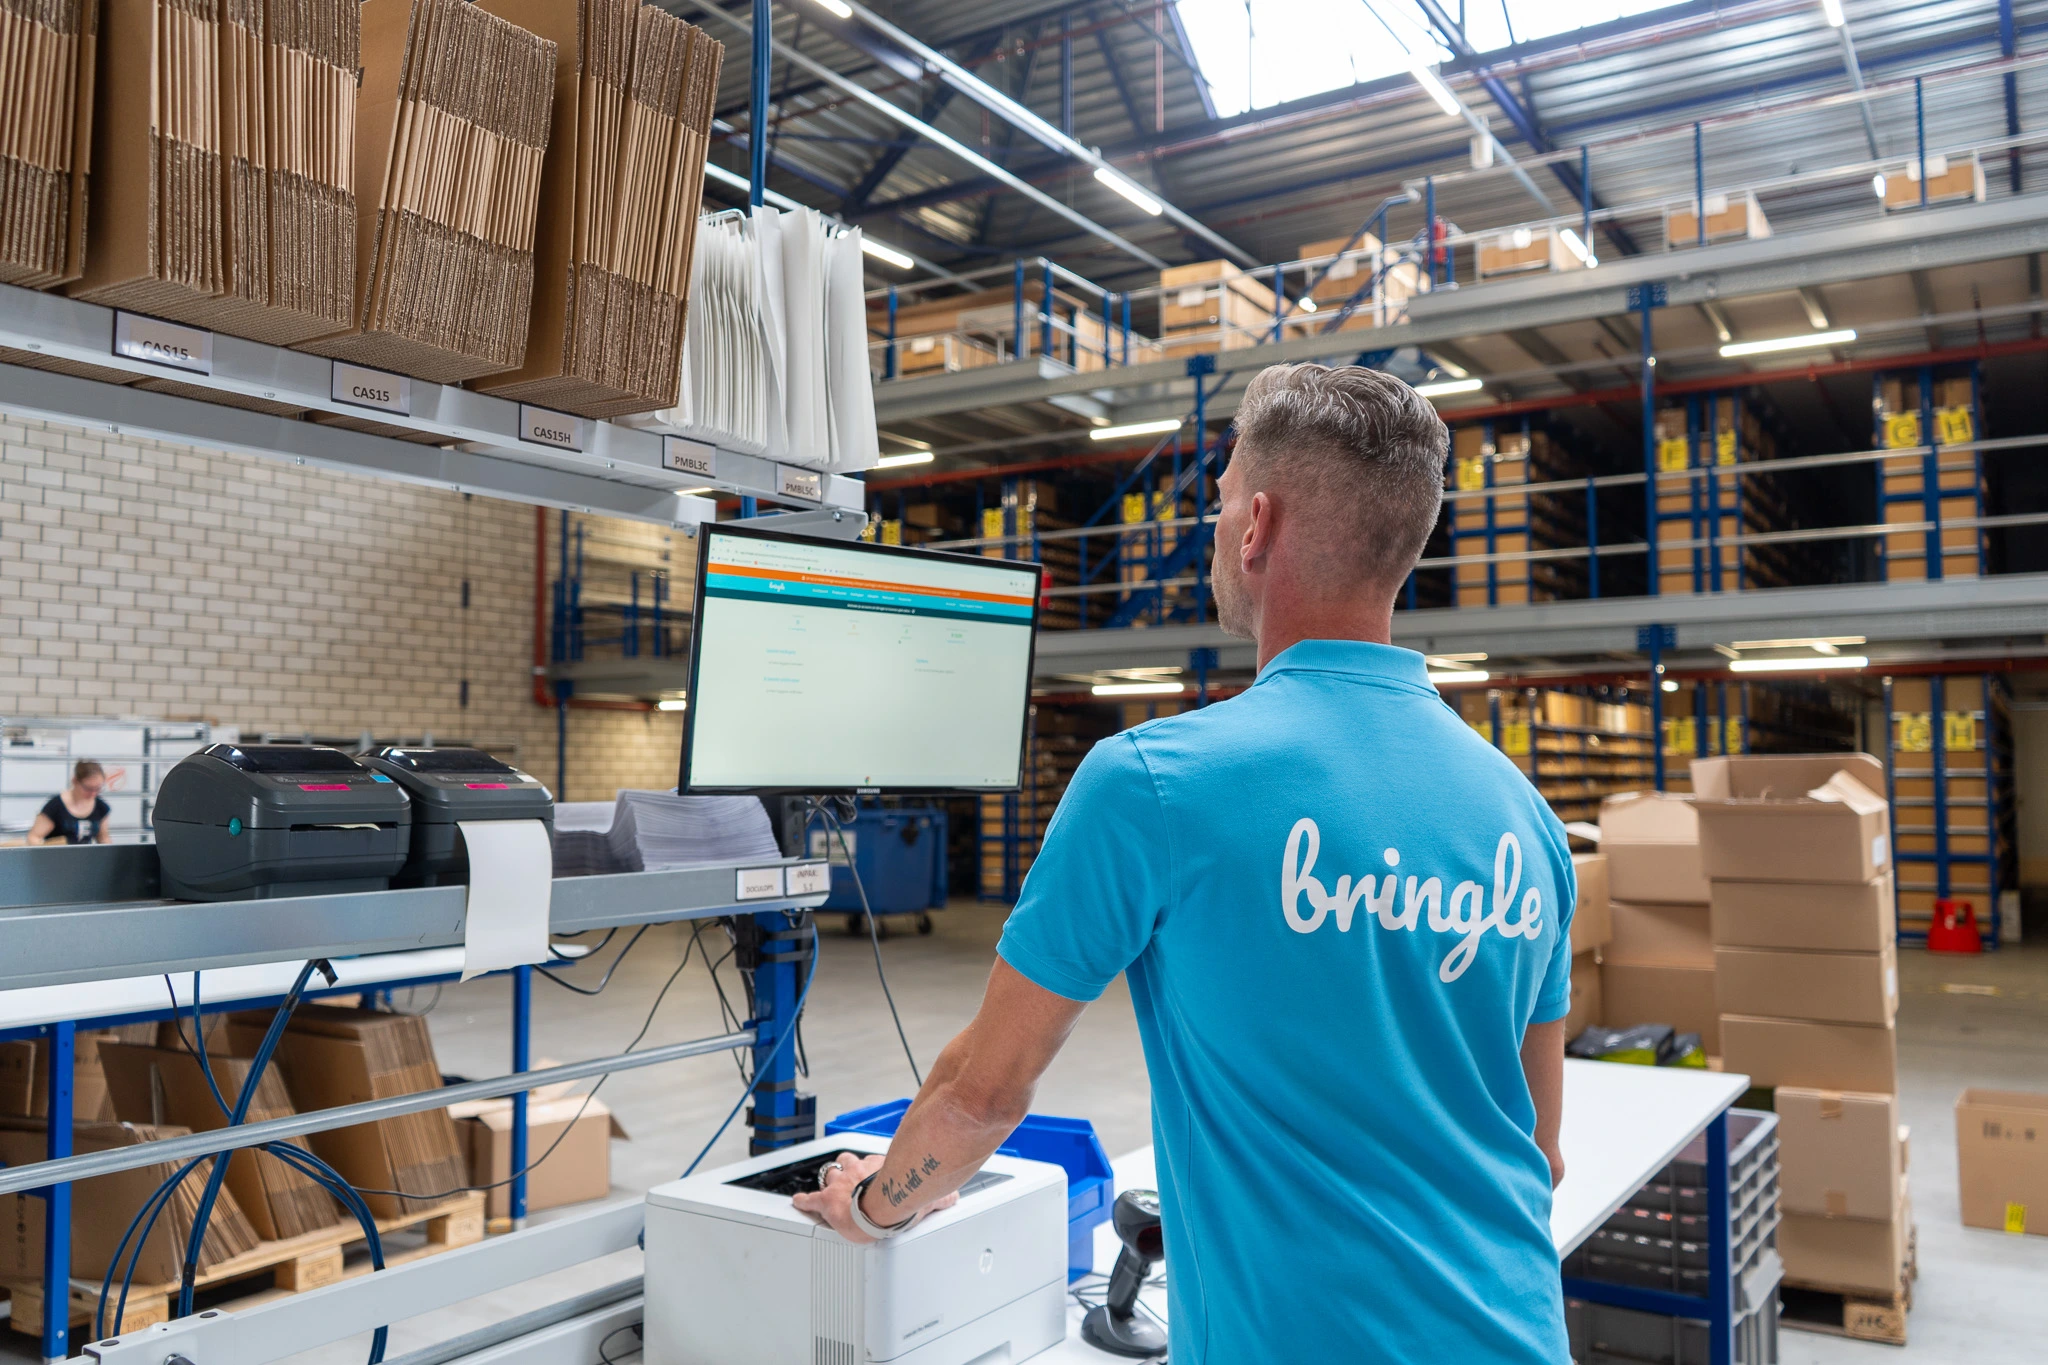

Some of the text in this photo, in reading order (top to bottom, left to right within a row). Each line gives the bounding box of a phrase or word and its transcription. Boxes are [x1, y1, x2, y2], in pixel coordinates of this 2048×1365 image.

[142, 340, 189, 361] CAS15
[352, 385, 390, 402] CAS15
[533, 426, 571, 444] CAS15H
[1946, 413, 1970, 442] H
[674, 455, 709, 472] PMBL3C
[1281, 817, 1543, 983] bringle
